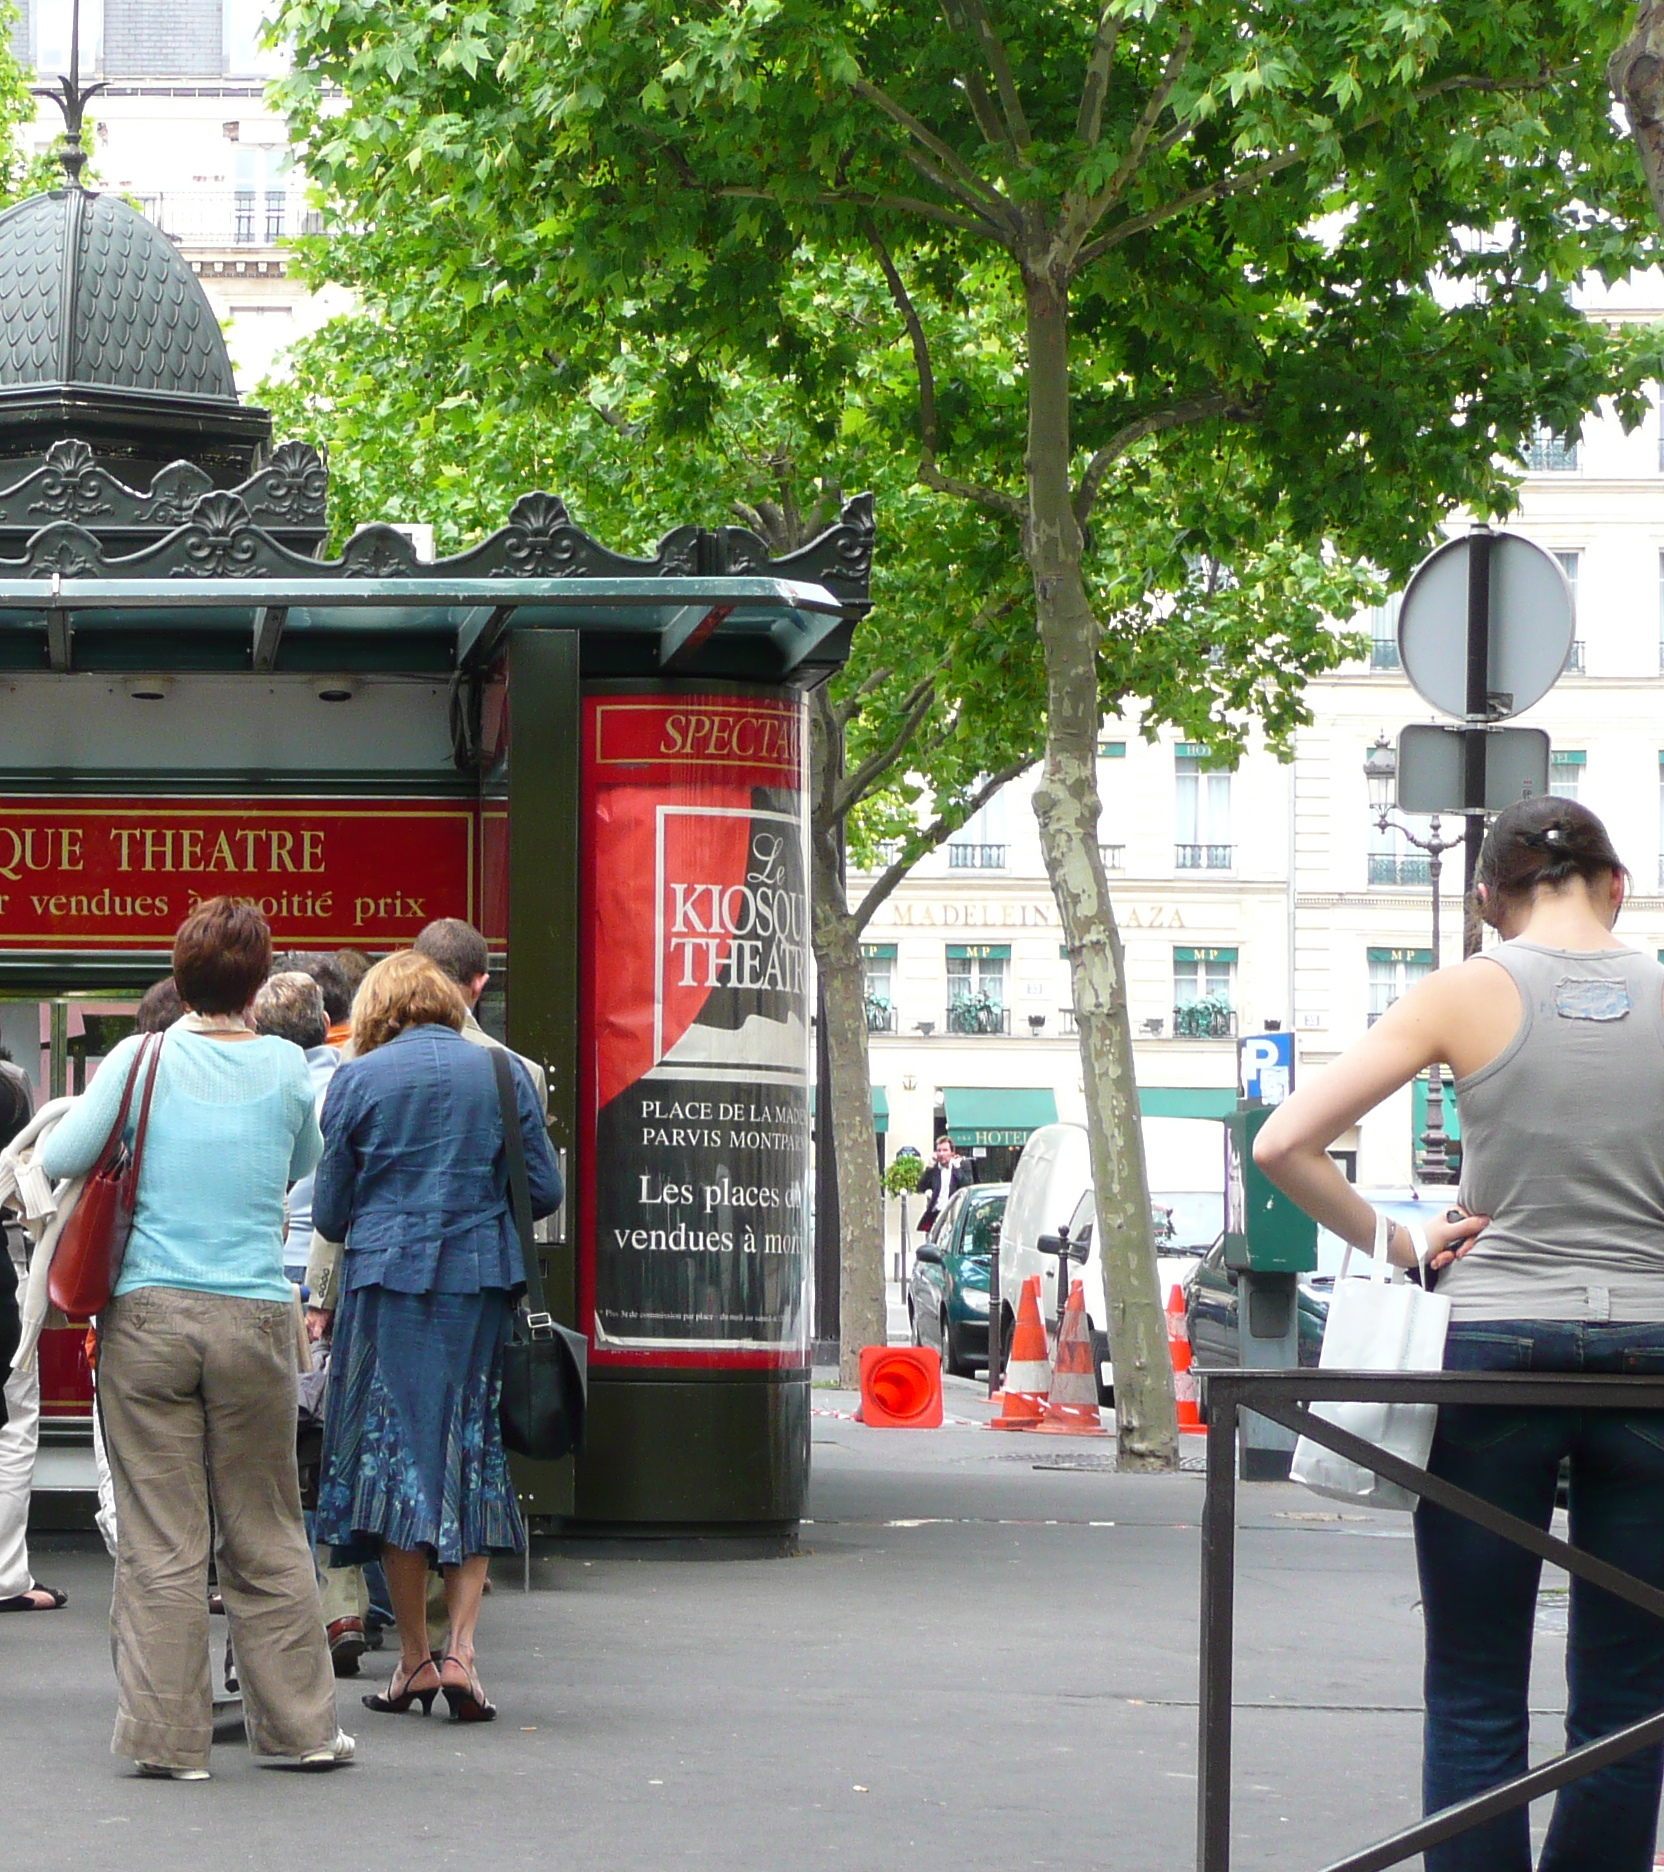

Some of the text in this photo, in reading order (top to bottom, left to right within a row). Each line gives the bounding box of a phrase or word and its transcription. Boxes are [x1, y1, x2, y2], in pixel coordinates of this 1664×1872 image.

[110, 828, 326, 873] THEATRE
[747, 832, 786, 886] Le
[31, 888, 169, 917] vendues
[354, 890, 426, 926] prix
[670, 883, 804, 947] KIOSQU
[894, 904, 1062, 927] MADELEIN
[670, 937, 806, 994] THEATR
[1245, 1039, 1279, 1081] P
[641, 1101, 712, 1121] PLACE
[720, 1104, 745, 1122] DE
[750, 1104, 771, 1123] LA
[642, 1128, 721, 1148] PARVIS
[638, 1174, 693, 1205] Les
[704, 1178, 780, 1214] places
[614, 1222, 733, 1252] vendues
[743, 1224, 757, 1254] à
